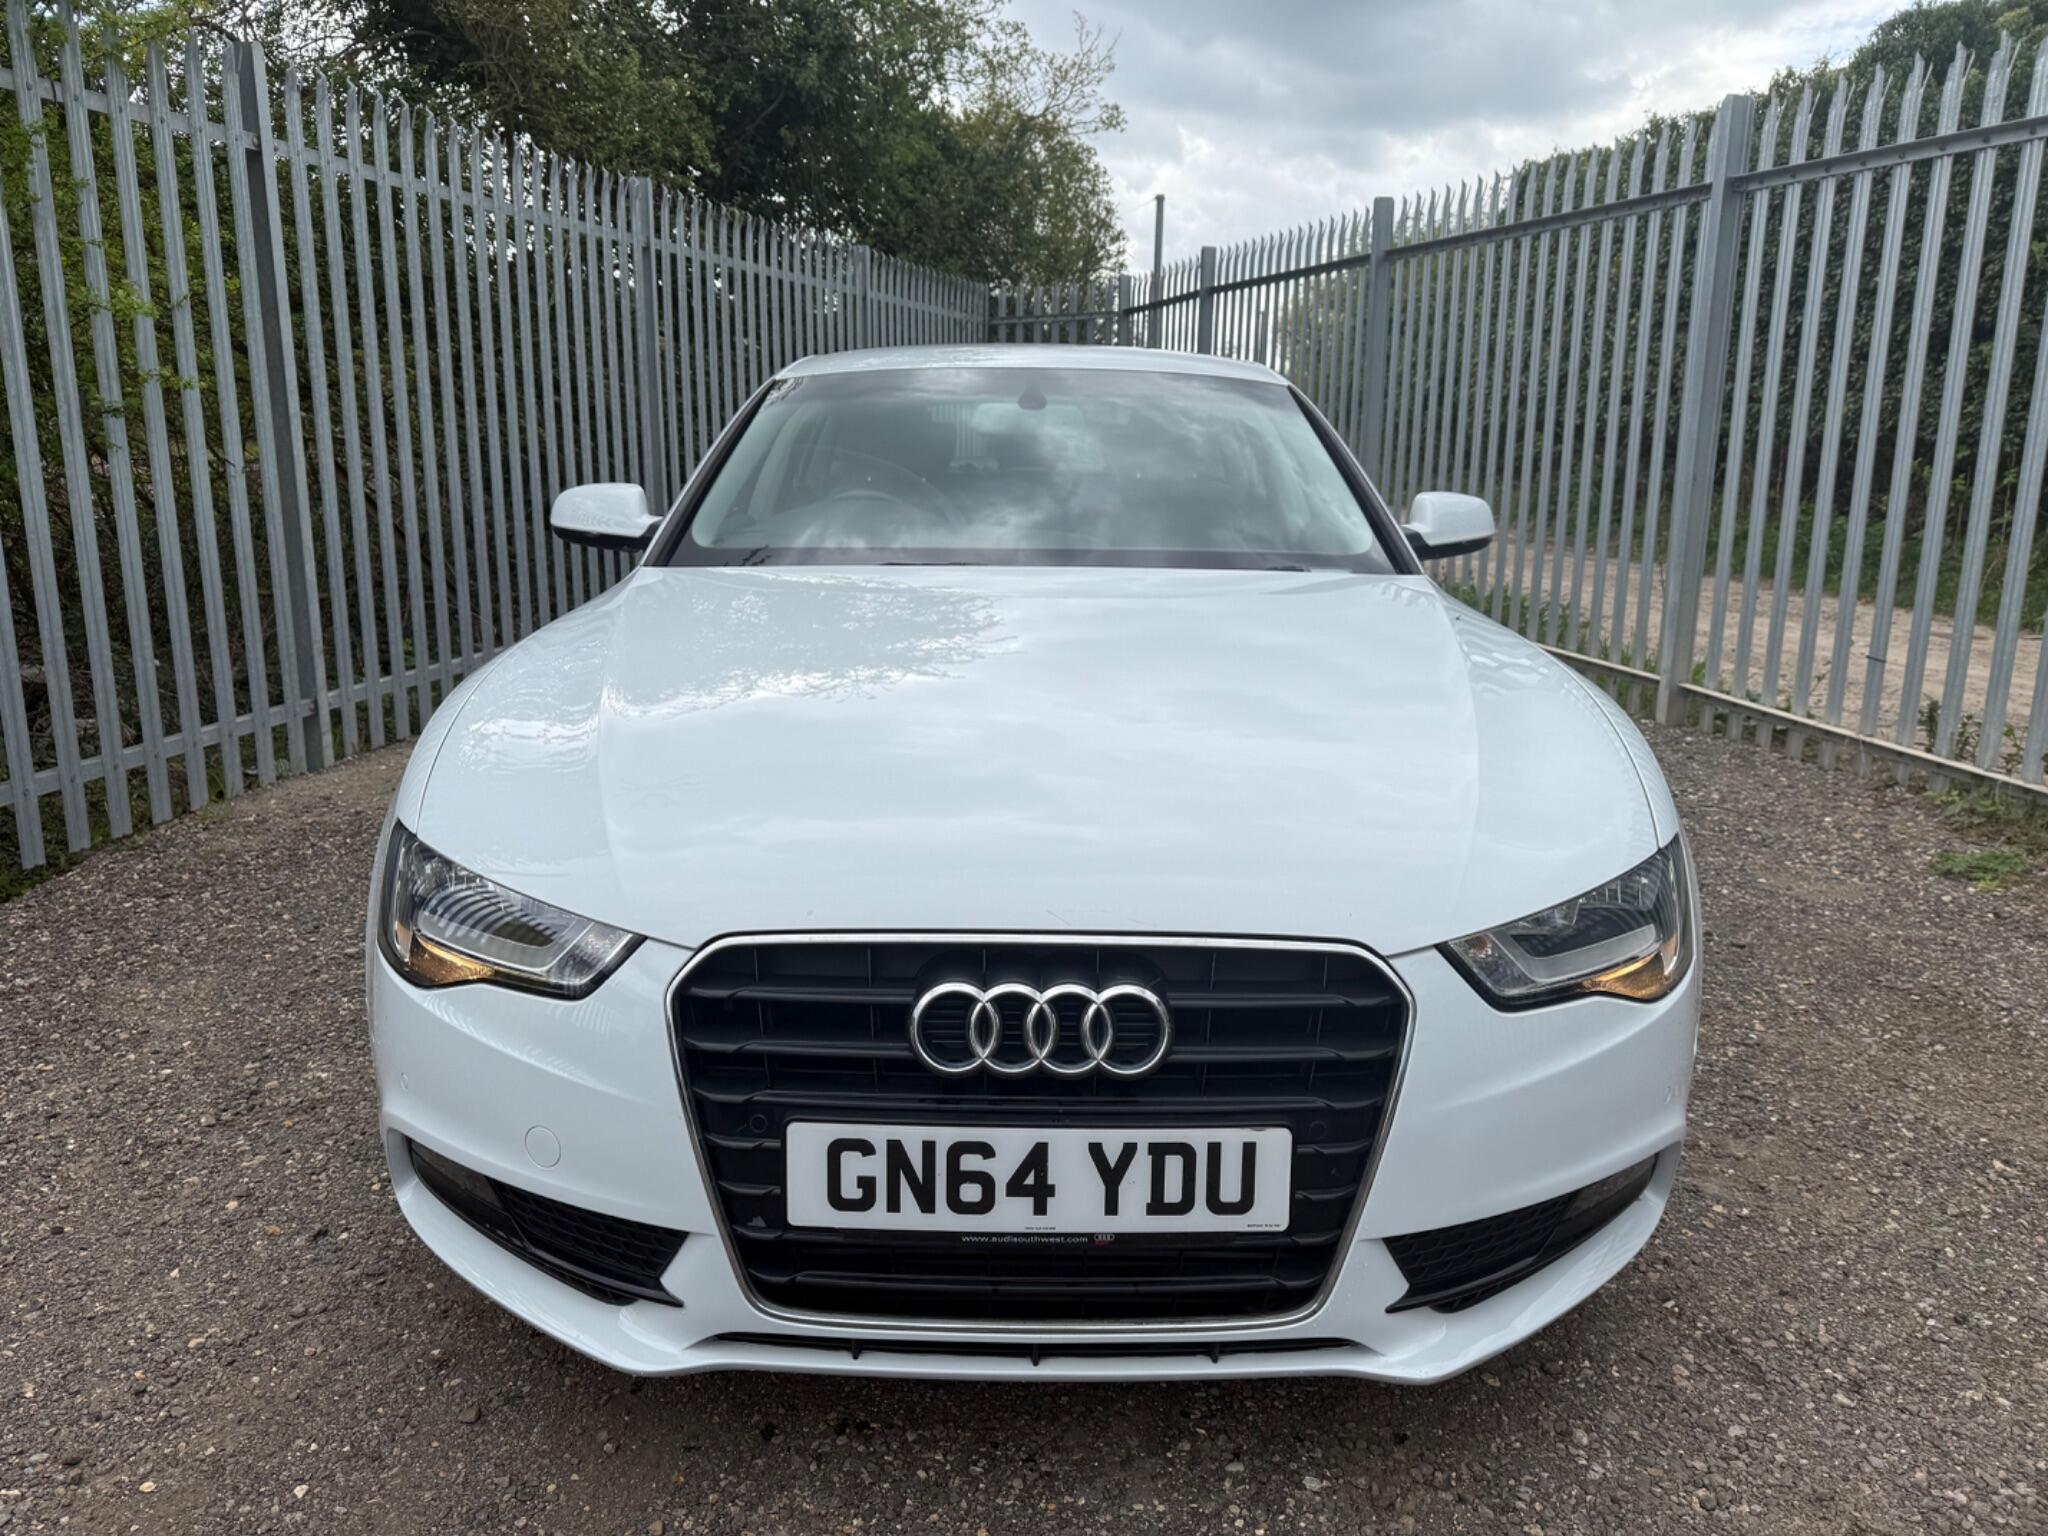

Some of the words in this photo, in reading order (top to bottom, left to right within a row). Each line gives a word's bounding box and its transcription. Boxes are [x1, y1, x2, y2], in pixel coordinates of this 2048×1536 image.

[826, 1137, 1056, 1217] GN64
[1087, 1141, 1257, 1217] YDU
[961, 1234, 1088, 1244] www.audisouthwest.com
